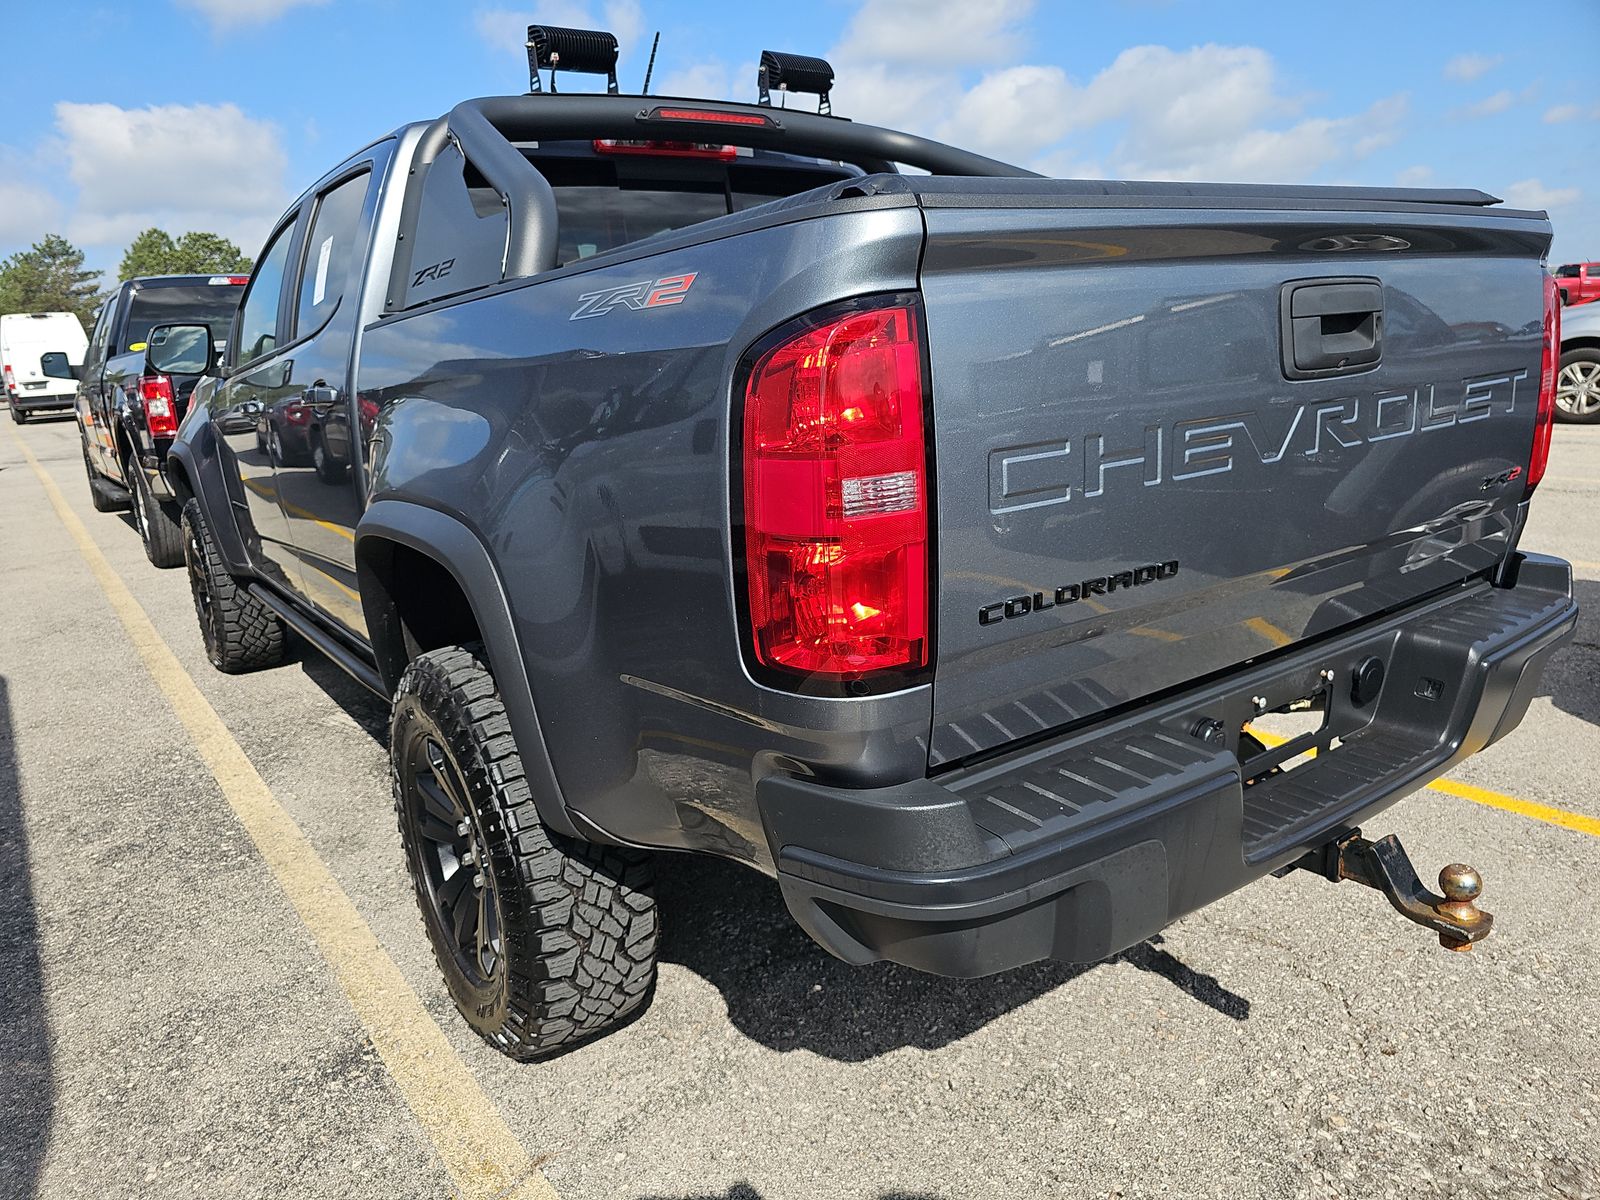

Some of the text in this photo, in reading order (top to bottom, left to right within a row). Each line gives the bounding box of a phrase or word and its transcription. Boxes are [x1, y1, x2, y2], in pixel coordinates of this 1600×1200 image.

[411, 257, 456, 288] ZR2
[569, 271, 700, 321] ZR2
[988, 368, 1528, 515] CHEVROLET
[978, 560, 1179, 626] COLORADO
